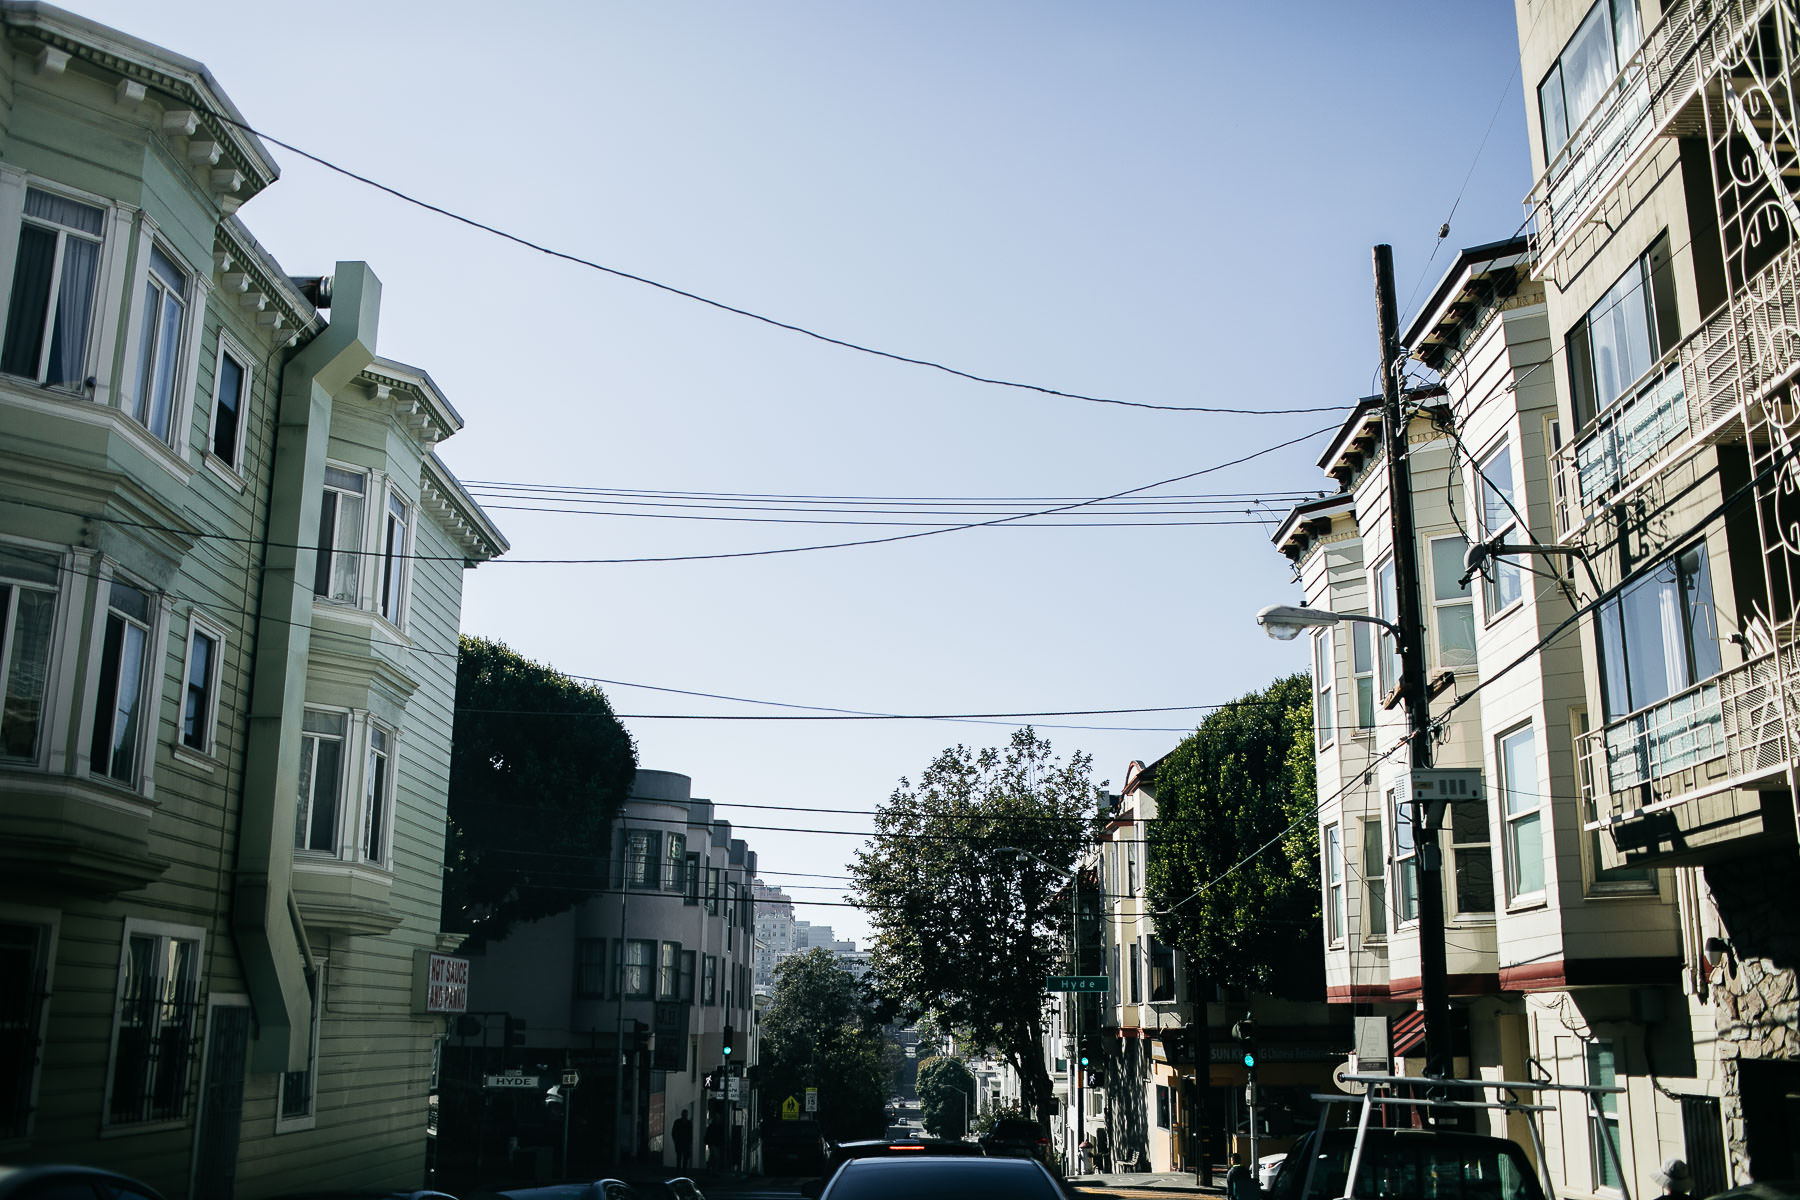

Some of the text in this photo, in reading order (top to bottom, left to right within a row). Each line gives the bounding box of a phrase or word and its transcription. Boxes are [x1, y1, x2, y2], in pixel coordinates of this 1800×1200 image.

[447, 960, 467, 984] SAUCE
[1061, 980, 1095, 990] Hyde
[1210, 1047, 1230, 1059] SUN
[496, 1078, 532, 1086] HYDE
